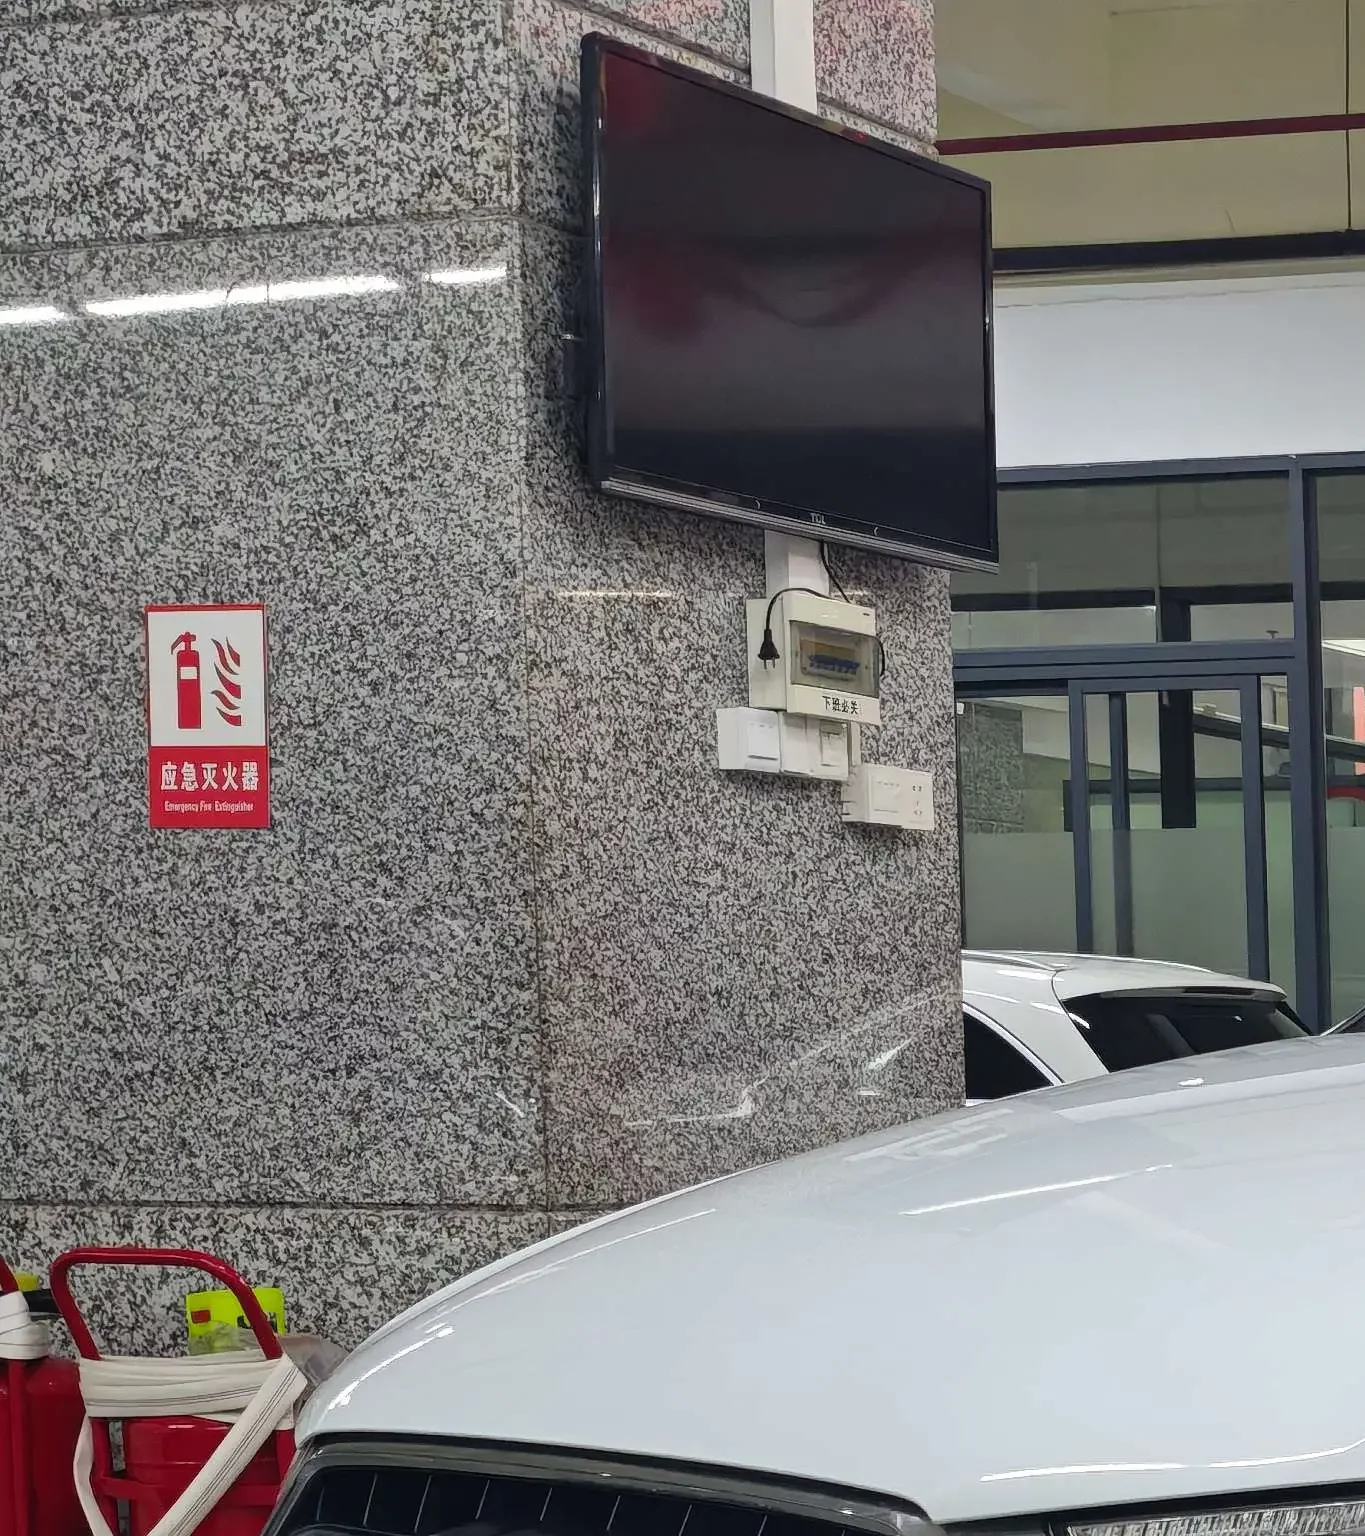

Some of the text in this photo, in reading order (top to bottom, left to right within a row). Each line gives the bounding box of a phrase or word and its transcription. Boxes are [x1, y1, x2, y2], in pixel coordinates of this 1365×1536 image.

[809, 512, 827, 525] TCL
[160, 761, 259, 792] 应急灭火器
[164, 800, 254, 814] Emergency Fire Extinguisher
